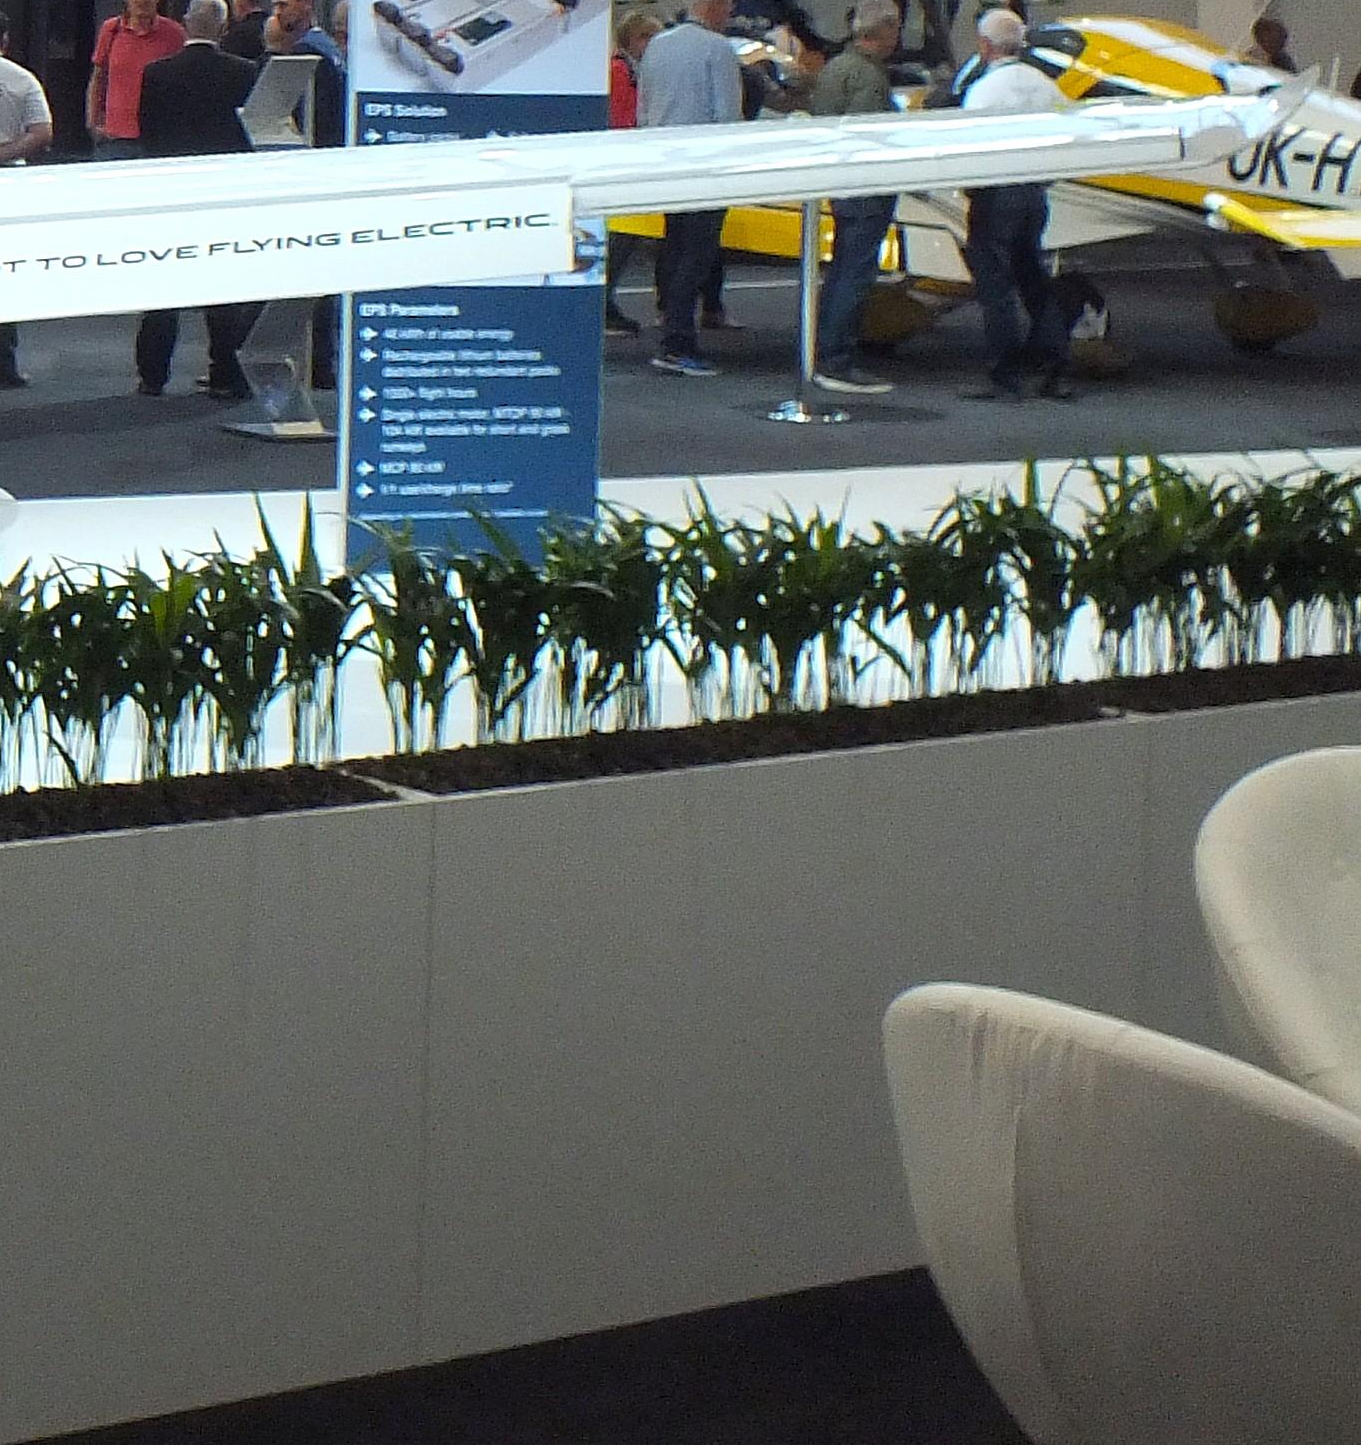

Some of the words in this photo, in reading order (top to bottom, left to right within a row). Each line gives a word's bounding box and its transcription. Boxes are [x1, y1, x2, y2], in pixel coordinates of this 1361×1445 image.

[35, 254, 88, 274] TO
[97, 245, 199, 267] LOVE
[208, 232, 342, 257] FLYING
